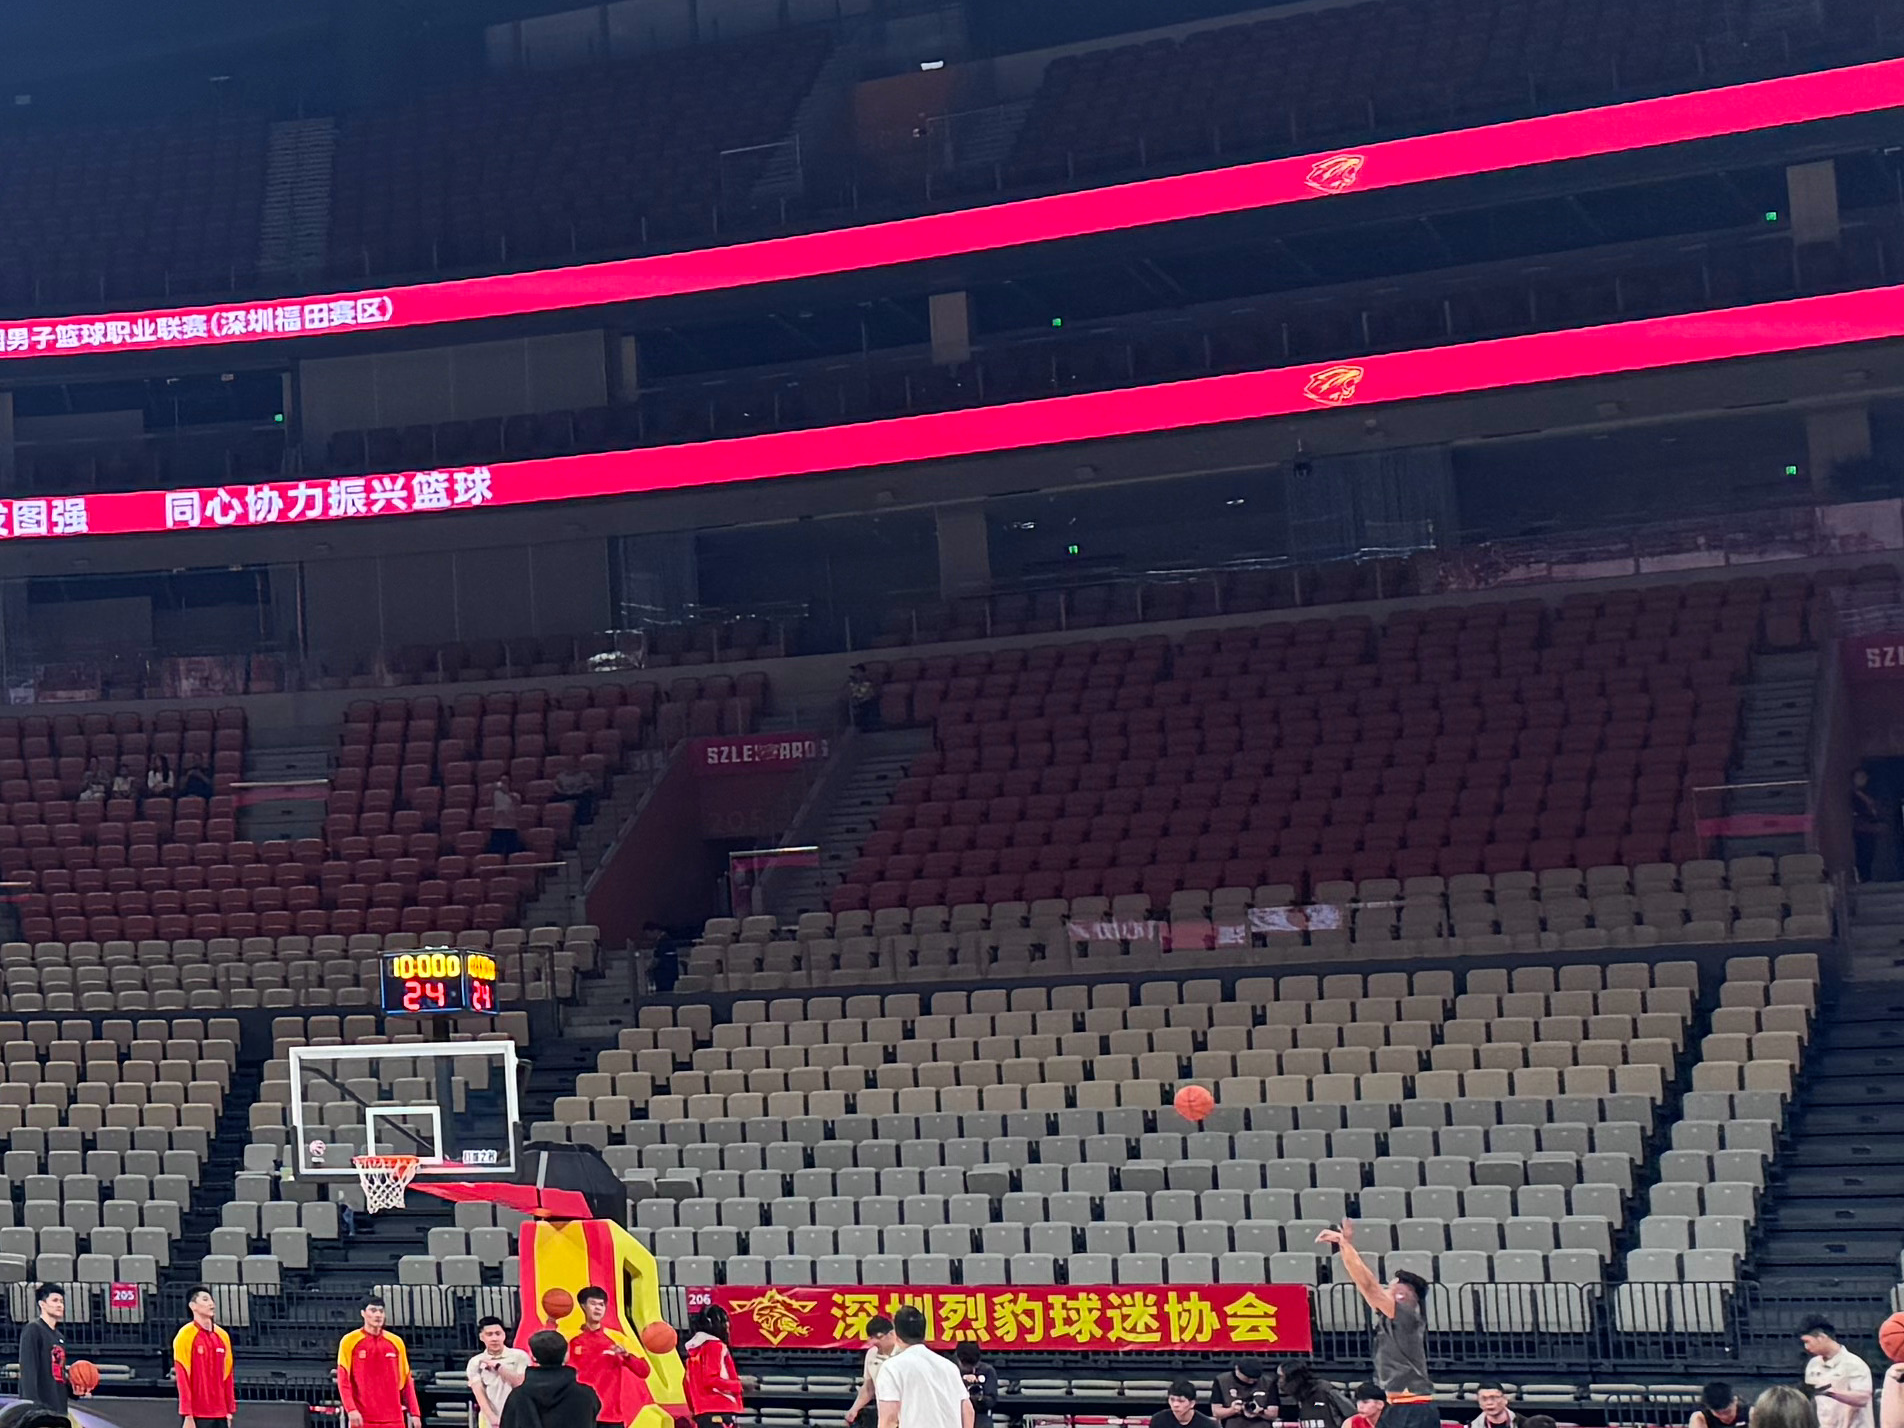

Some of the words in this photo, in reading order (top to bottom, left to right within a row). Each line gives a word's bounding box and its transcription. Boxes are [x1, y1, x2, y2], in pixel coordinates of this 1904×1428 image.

[164, 466, 493, 529] 同心协力振兴篮球
[403, 980, 445, 1011] 24
[688, 1294, 712, 1306] 206
